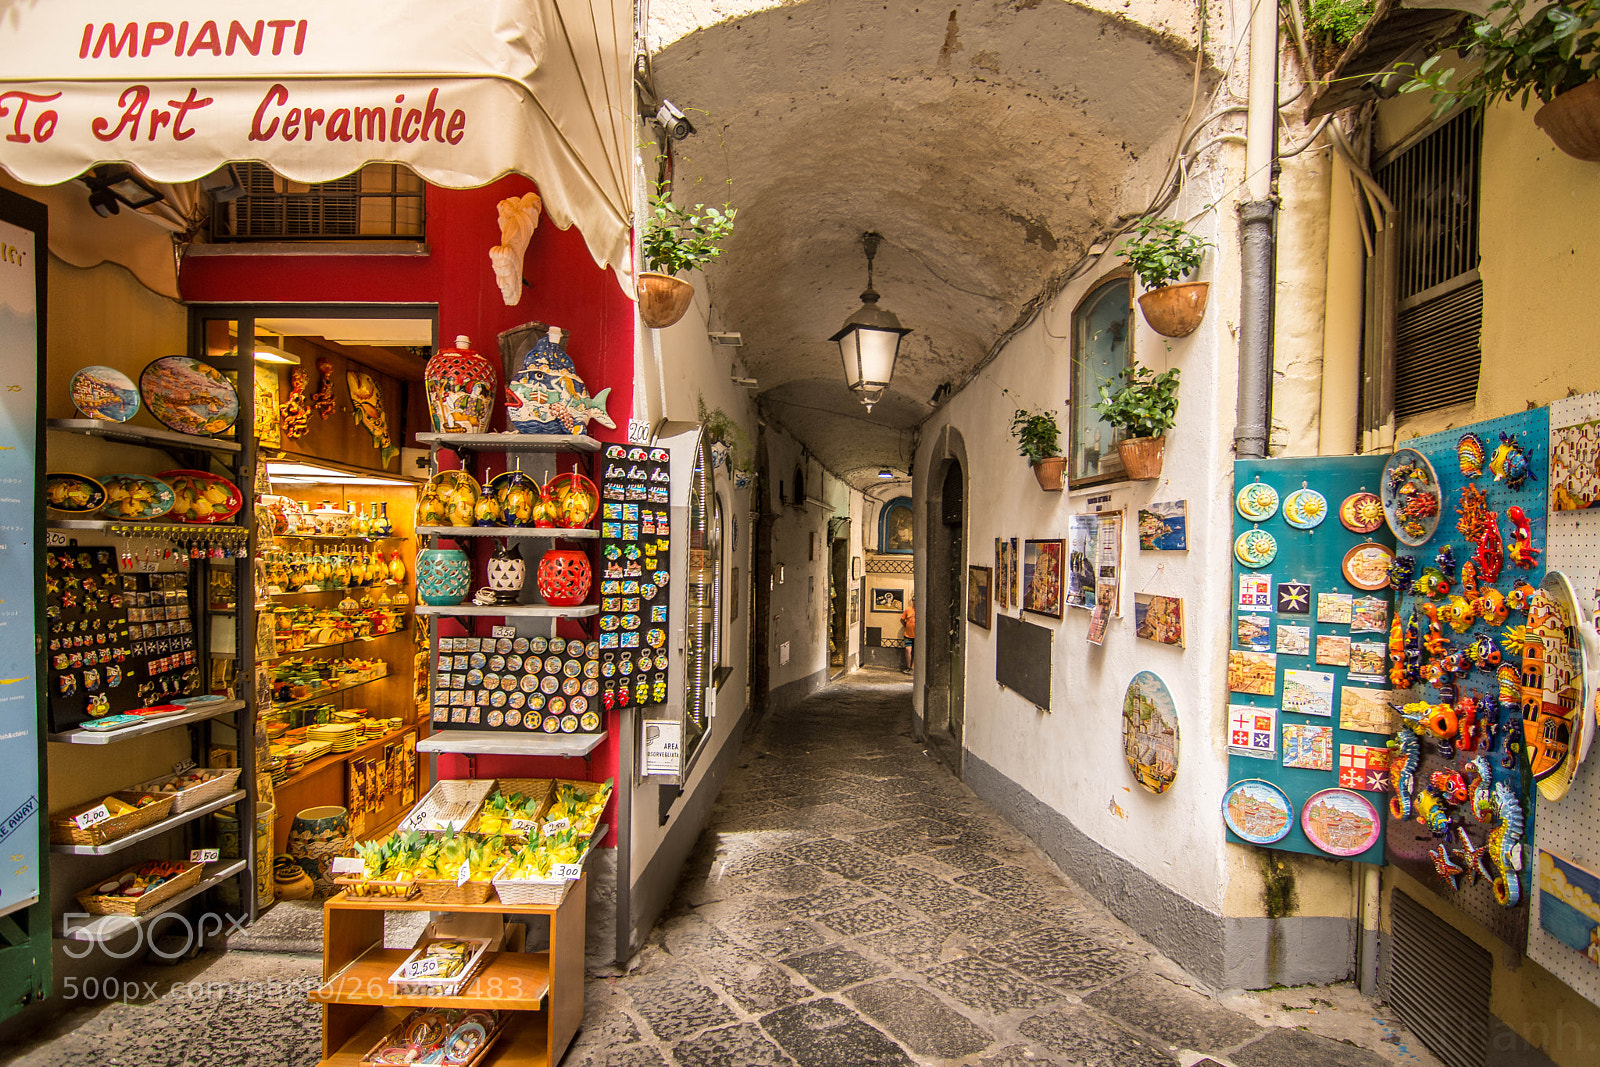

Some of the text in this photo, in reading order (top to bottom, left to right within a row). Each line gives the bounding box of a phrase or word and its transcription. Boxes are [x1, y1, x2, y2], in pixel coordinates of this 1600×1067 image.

[79, 19, 308, 59] IMPIANTI
[0, 84, 466, 146] To Art Ceramiche
[664, 742, 679, 750] AREA
[8, 801, 34, 828] AWAY
[82, 810, 104, 824] 2,00
